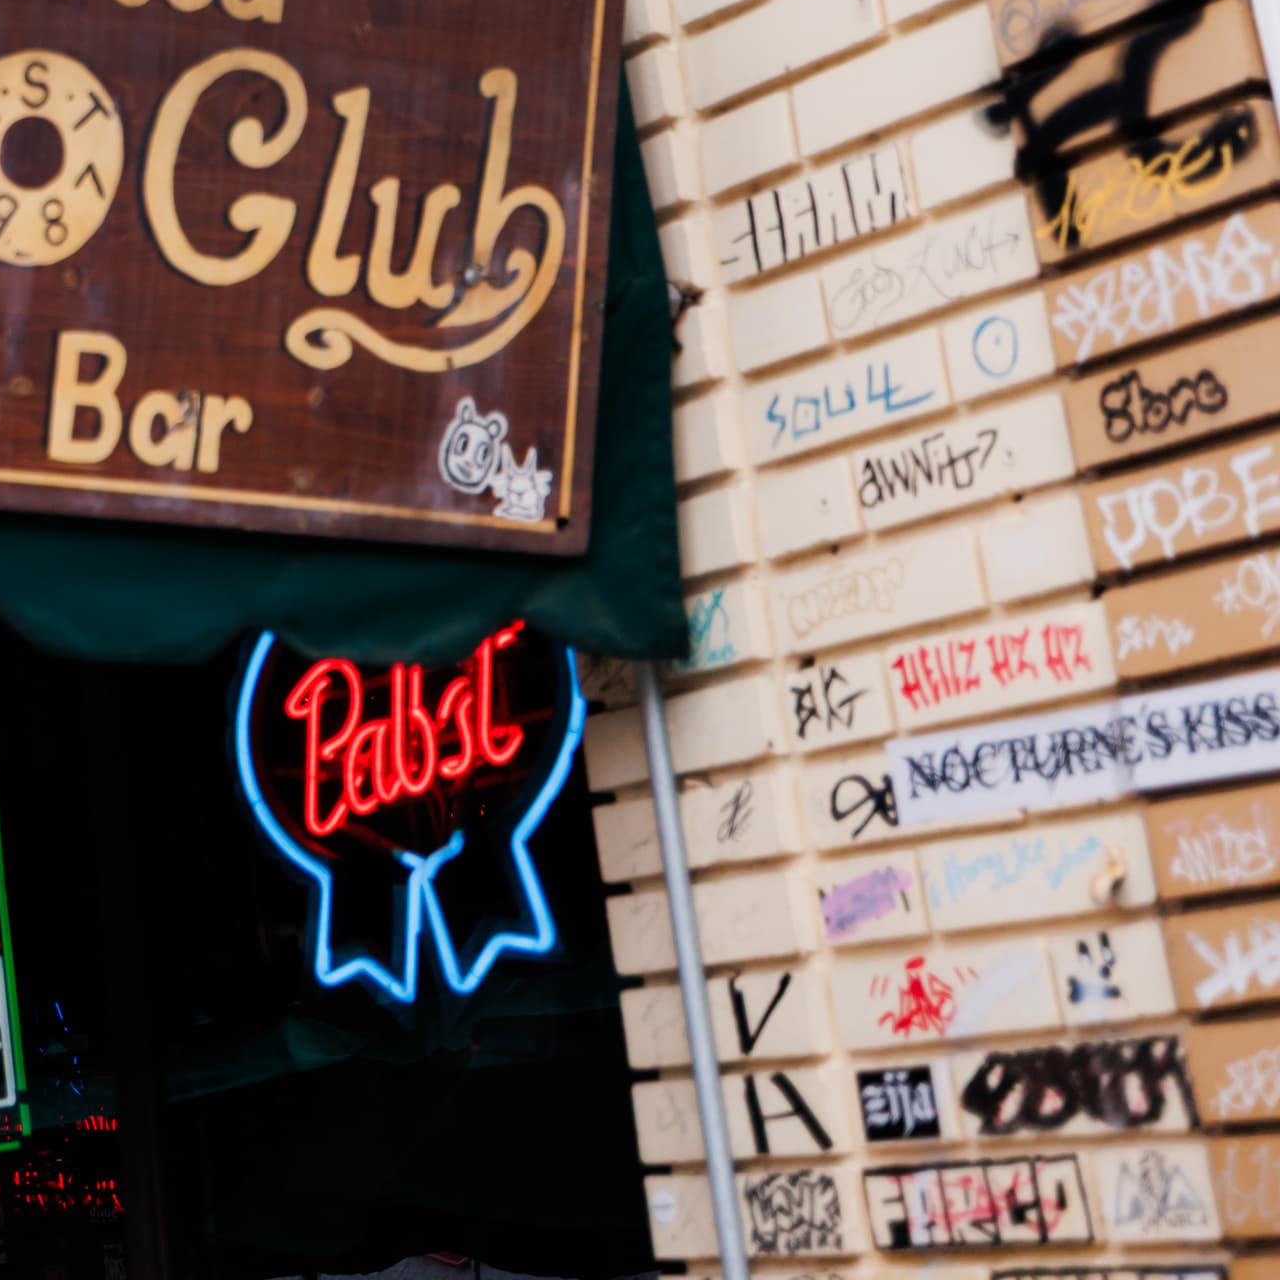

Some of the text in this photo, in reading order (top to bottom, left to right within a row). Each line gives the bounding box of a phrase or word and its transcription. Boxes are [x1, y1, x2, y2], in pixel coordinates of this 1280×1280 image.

[47, 330, 254, 476] Bar
[284, 618, 527, 837] Pabst
[1177, 691, 1280, 754] KISS
